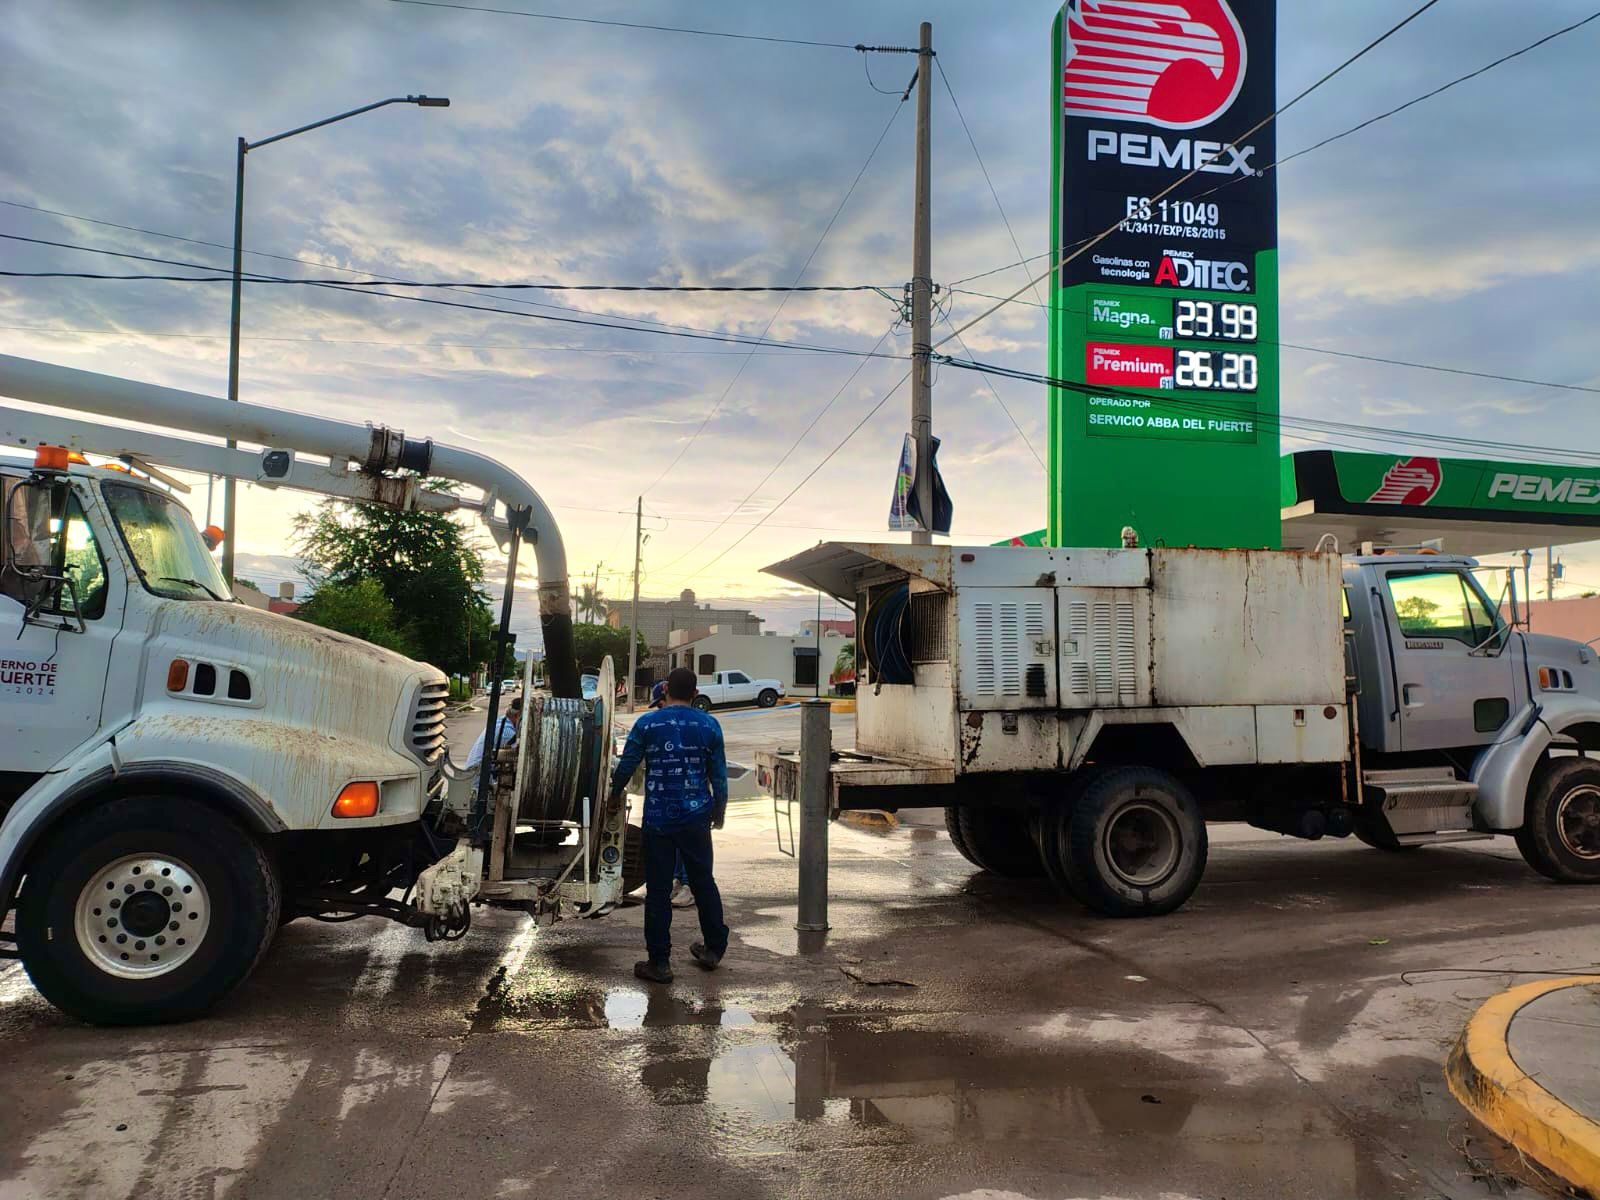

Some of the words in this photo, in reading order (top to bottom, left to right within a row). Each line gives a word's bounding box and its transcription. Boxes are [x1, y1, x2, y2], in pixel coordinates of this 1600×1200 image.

[1087, 129, 1256, 177] PEMEX
[1126, 196, 1151, 221] ES
[1158, 200, 1219, 226] 11049
[1092, 254, 1133, 267] Gasolinas
[1134, 260, 1150, 268] con
[1163, 249, 1194, 259] PEMEX
[1176, 300, 1258, 340] 23.99
[1175, 350, 1258, 390] 26.20
[1089, 397, 1132, 407] OPERADO
[1132, 399, 1151, 408] POR
[1089, 413, 1145, 427] SERVICIO
[1147, 417, 1180, 429] ABBA
[1182, 418, 1206, 430] DEL
[1208, 420, 1253, 433] FUERTE
[0, 660, 37, 671] ERNO
[40, 663, 58, 672] DE
[0, 671, 56, 686] UERTE
